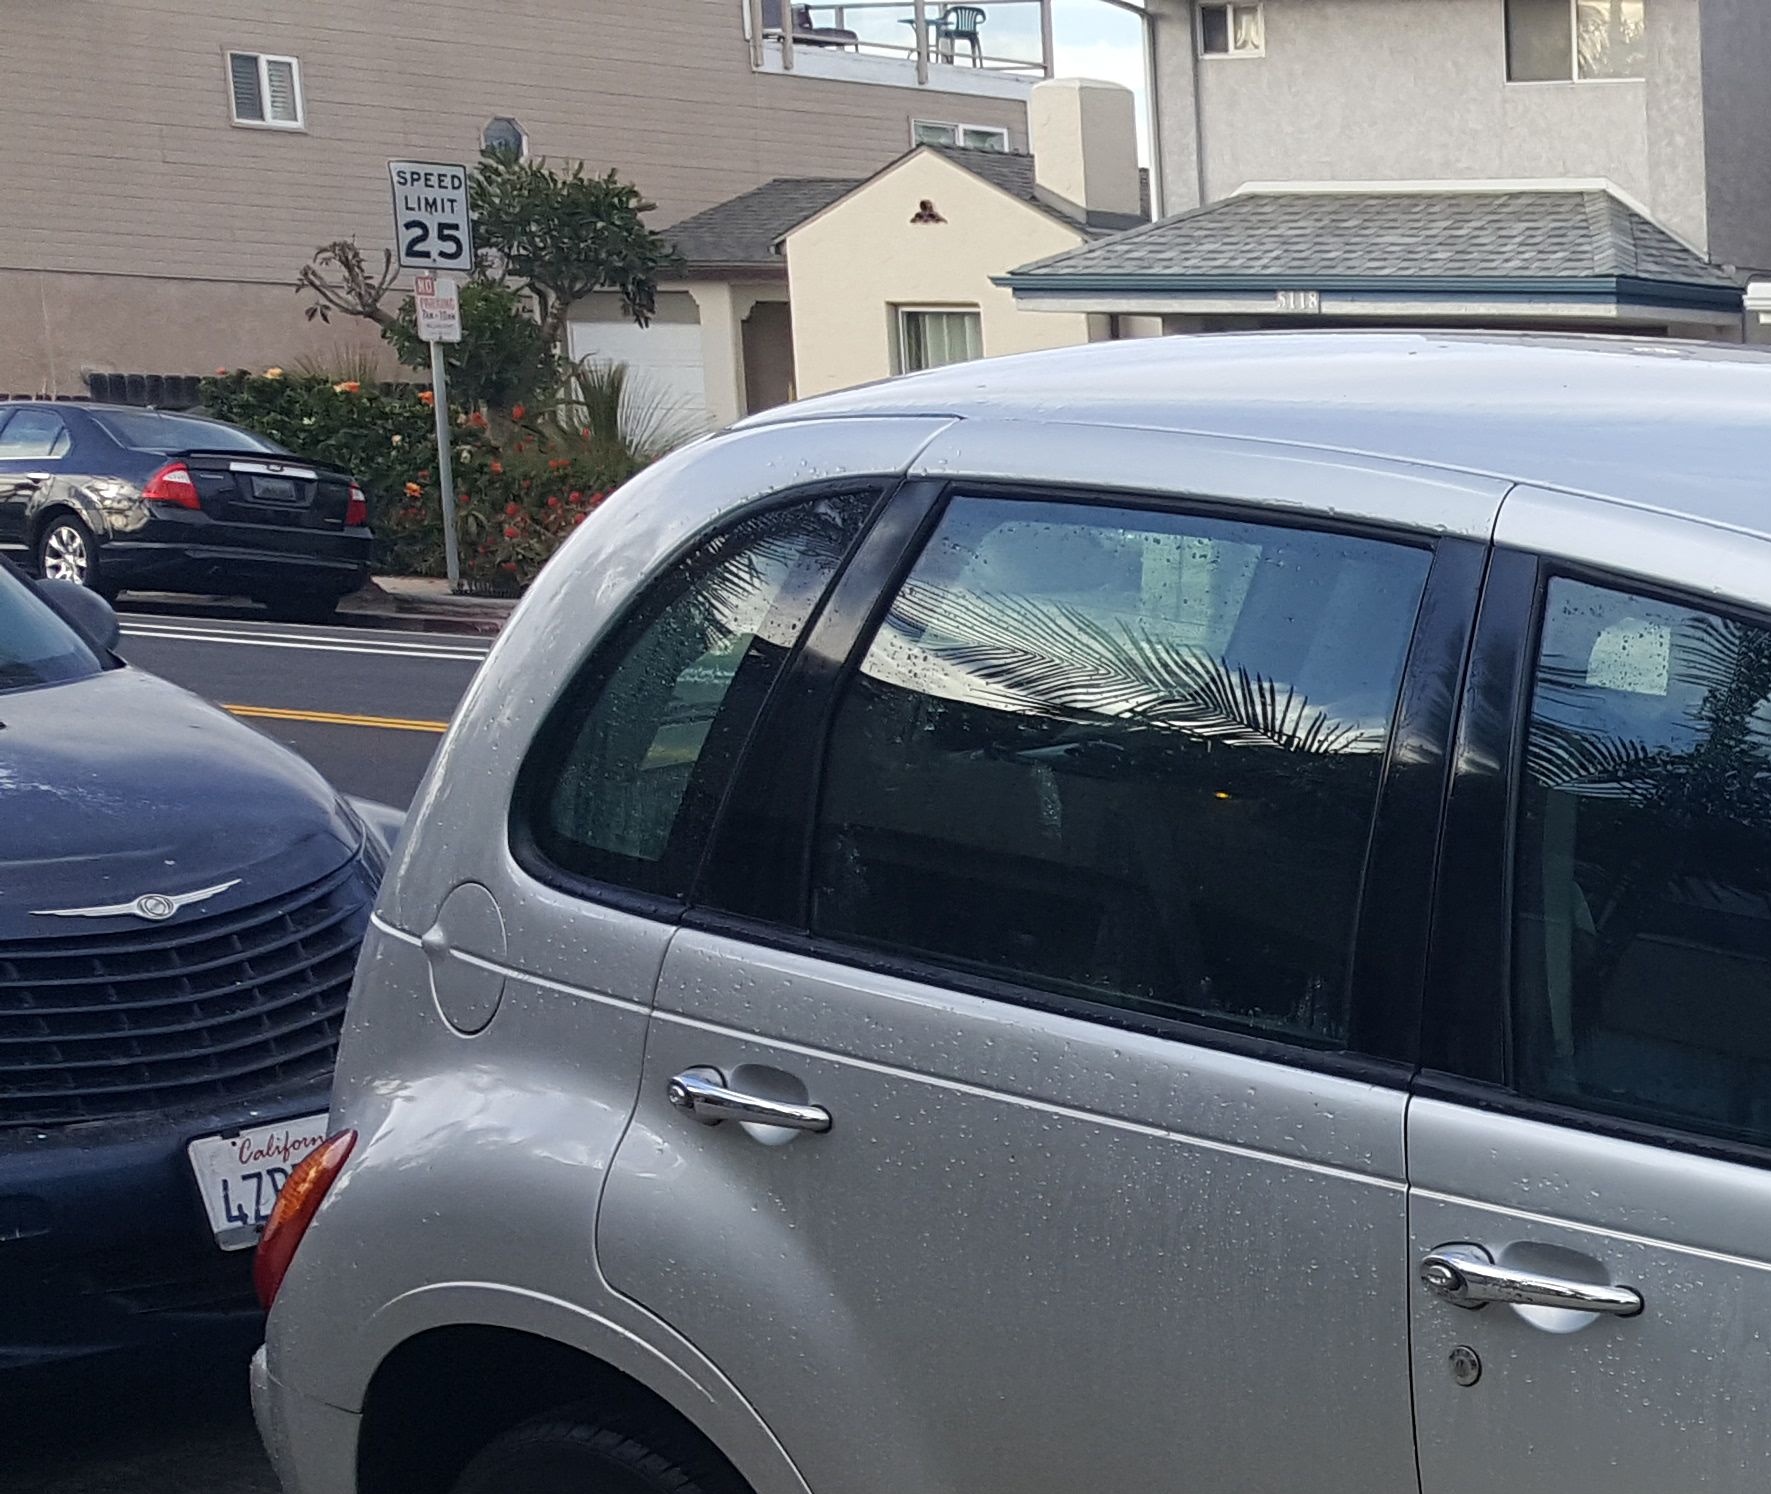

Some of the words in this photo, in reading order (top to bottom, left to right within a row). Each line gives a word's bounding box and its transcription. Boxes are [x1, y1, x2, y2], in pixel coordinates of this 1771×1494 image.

[396, 170, 462, 190] SPEED
[404, 194, 457, 215] LIMIT
[403, 219, 463, 260] 25
[1277, 291, 1317, 309] 5118
